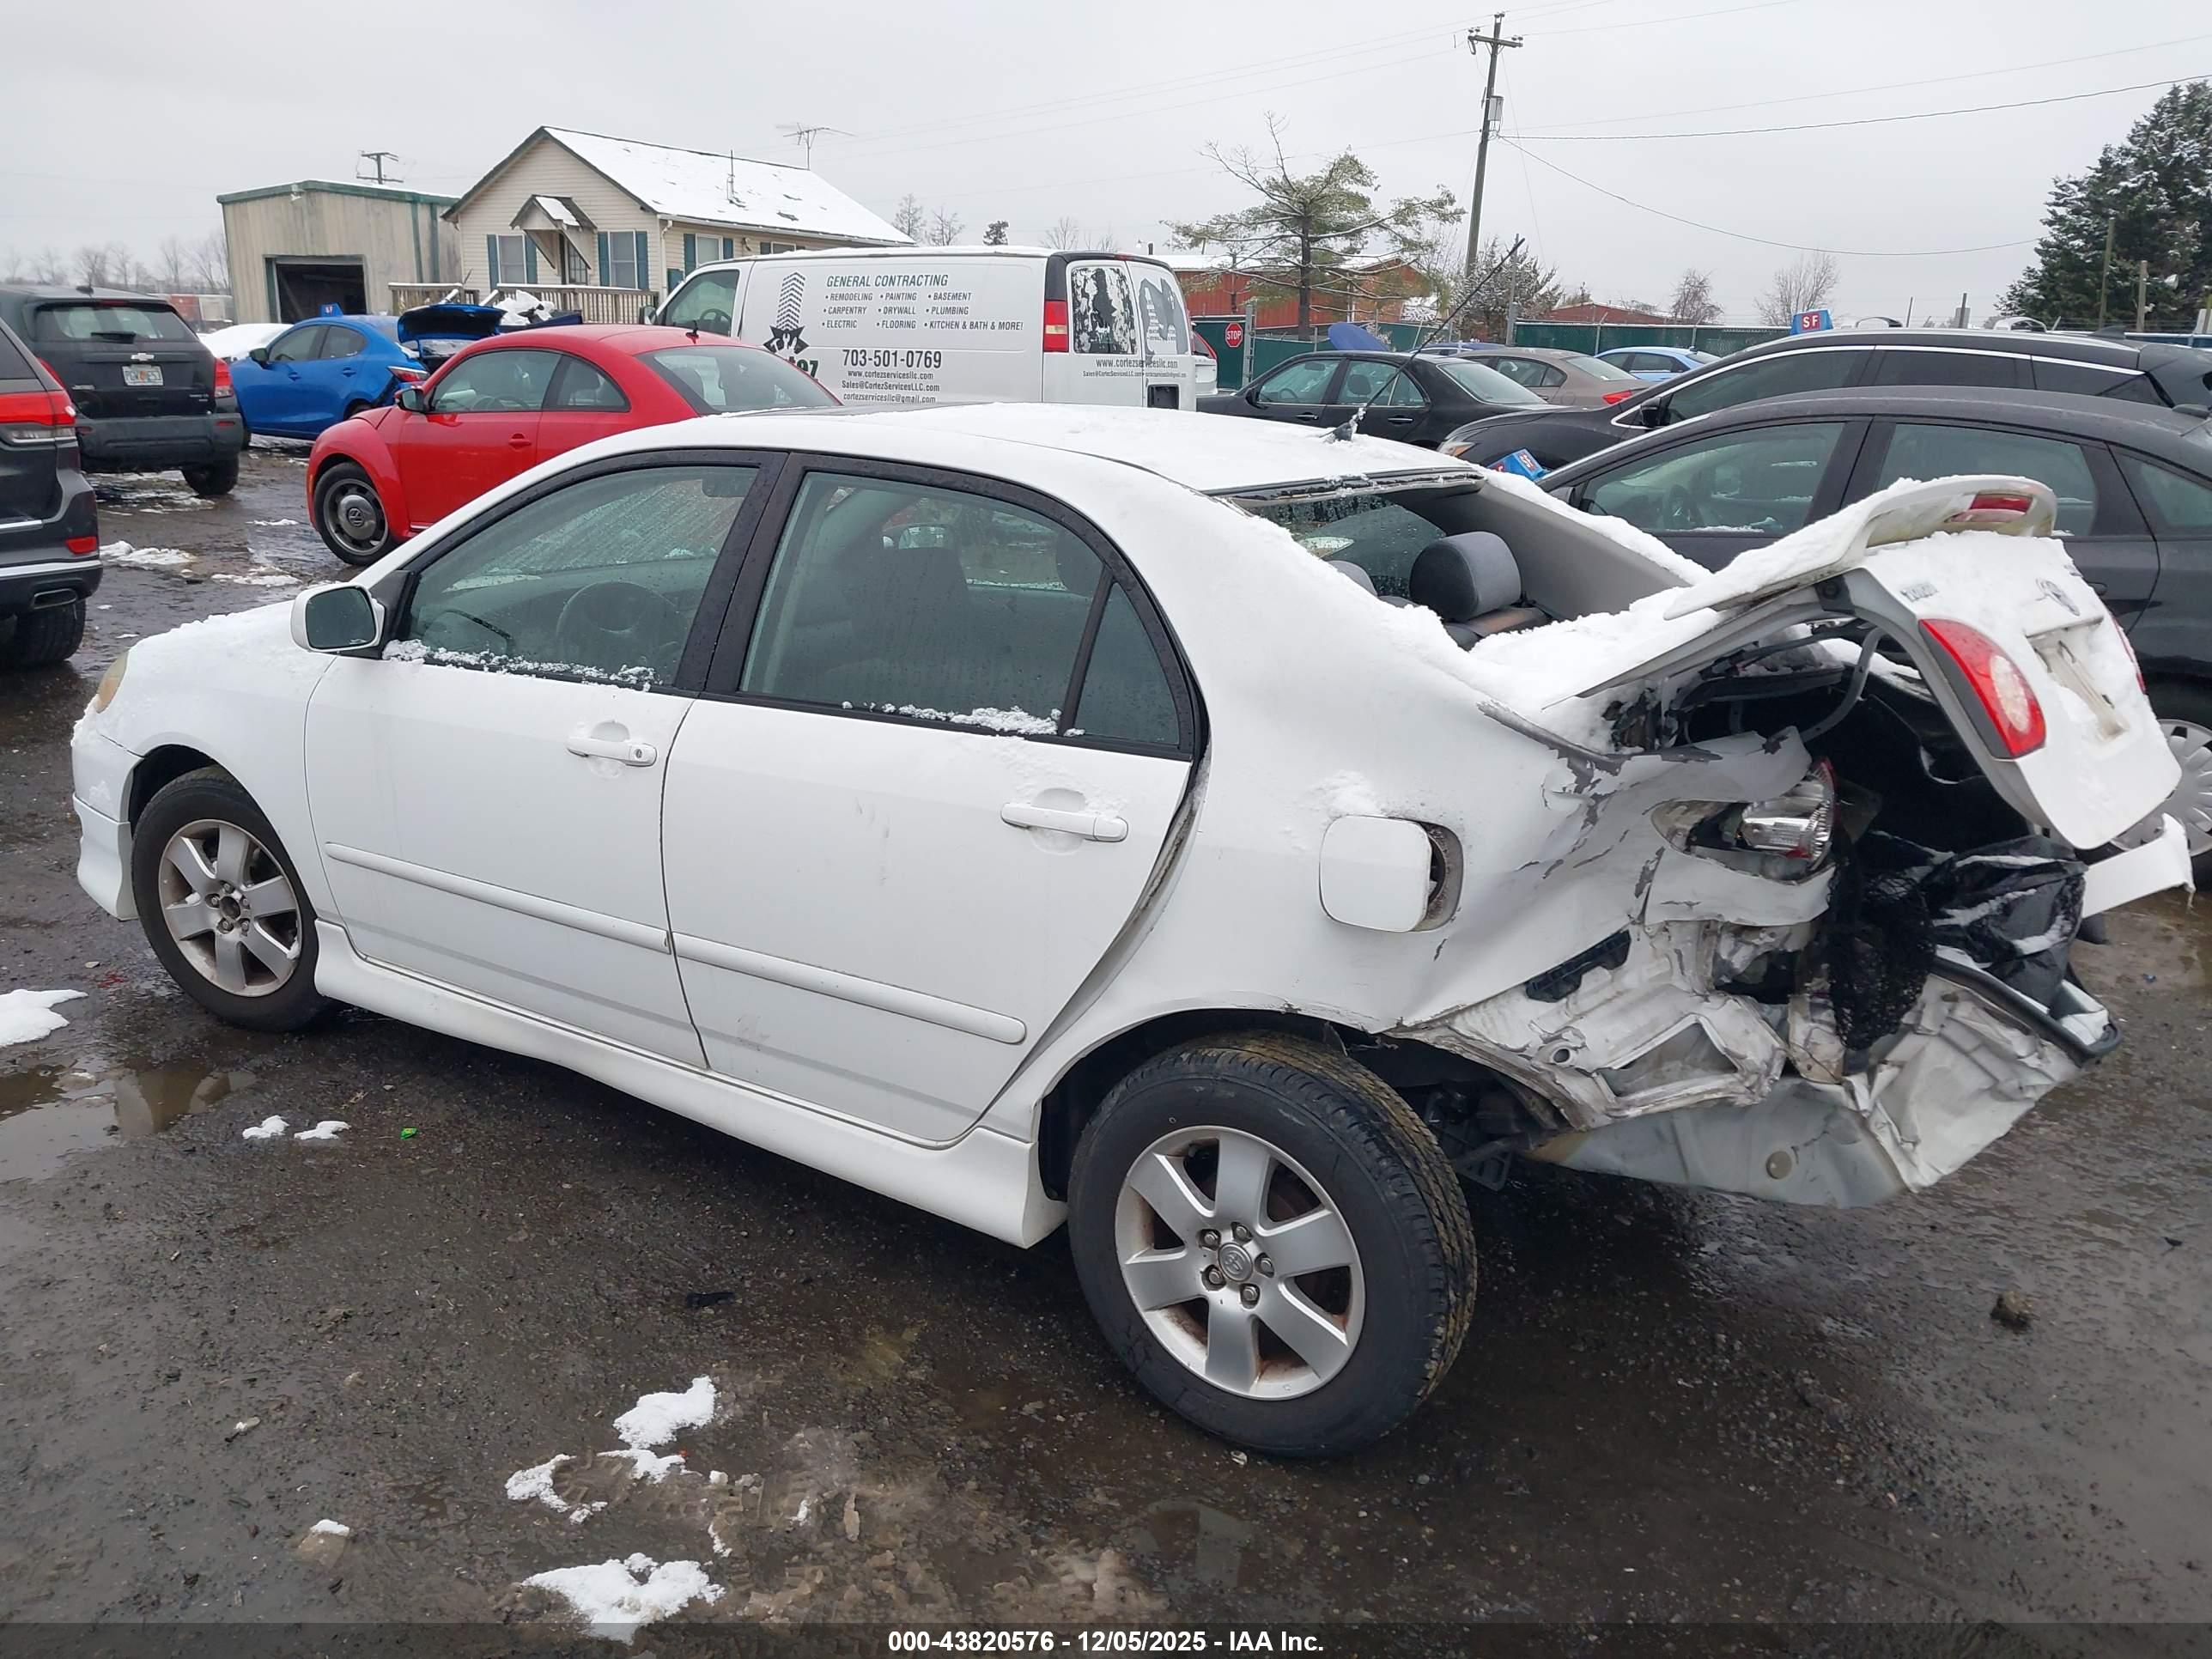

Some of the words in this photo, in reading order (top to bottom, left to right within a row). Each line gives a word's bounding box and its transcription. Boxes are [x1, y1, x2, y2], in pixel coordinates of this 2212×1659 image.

[827, 275, 871, 288] GENERAL
[874, 274, 949, 287] CONTRACTING
[884, 292, 917, 301] PAINTING
[933, 292, 972, 301] BASEMENT
[828, 306, 867, 314] CARPENTRY
[883, 306, 915, 314] DRYWALL
[931, 306, 969, 315] PLUMBING
[826, 319, 858, 328] ELECTRIC
[881, 319, 916, 329] FLOORING
[929, 320, 960, 330] KITCHEN
[961, 321, 968, 330] &
[969, 321, 988, 330] BATH
[990, 321, 996, 331] &
[998, 321, 1024, 331] MORE!
[1803, 314, 1819, 328] SF
[1226, 330, 1242, 340] STOP
[842, 349, 942, 368] 703-501-0769
